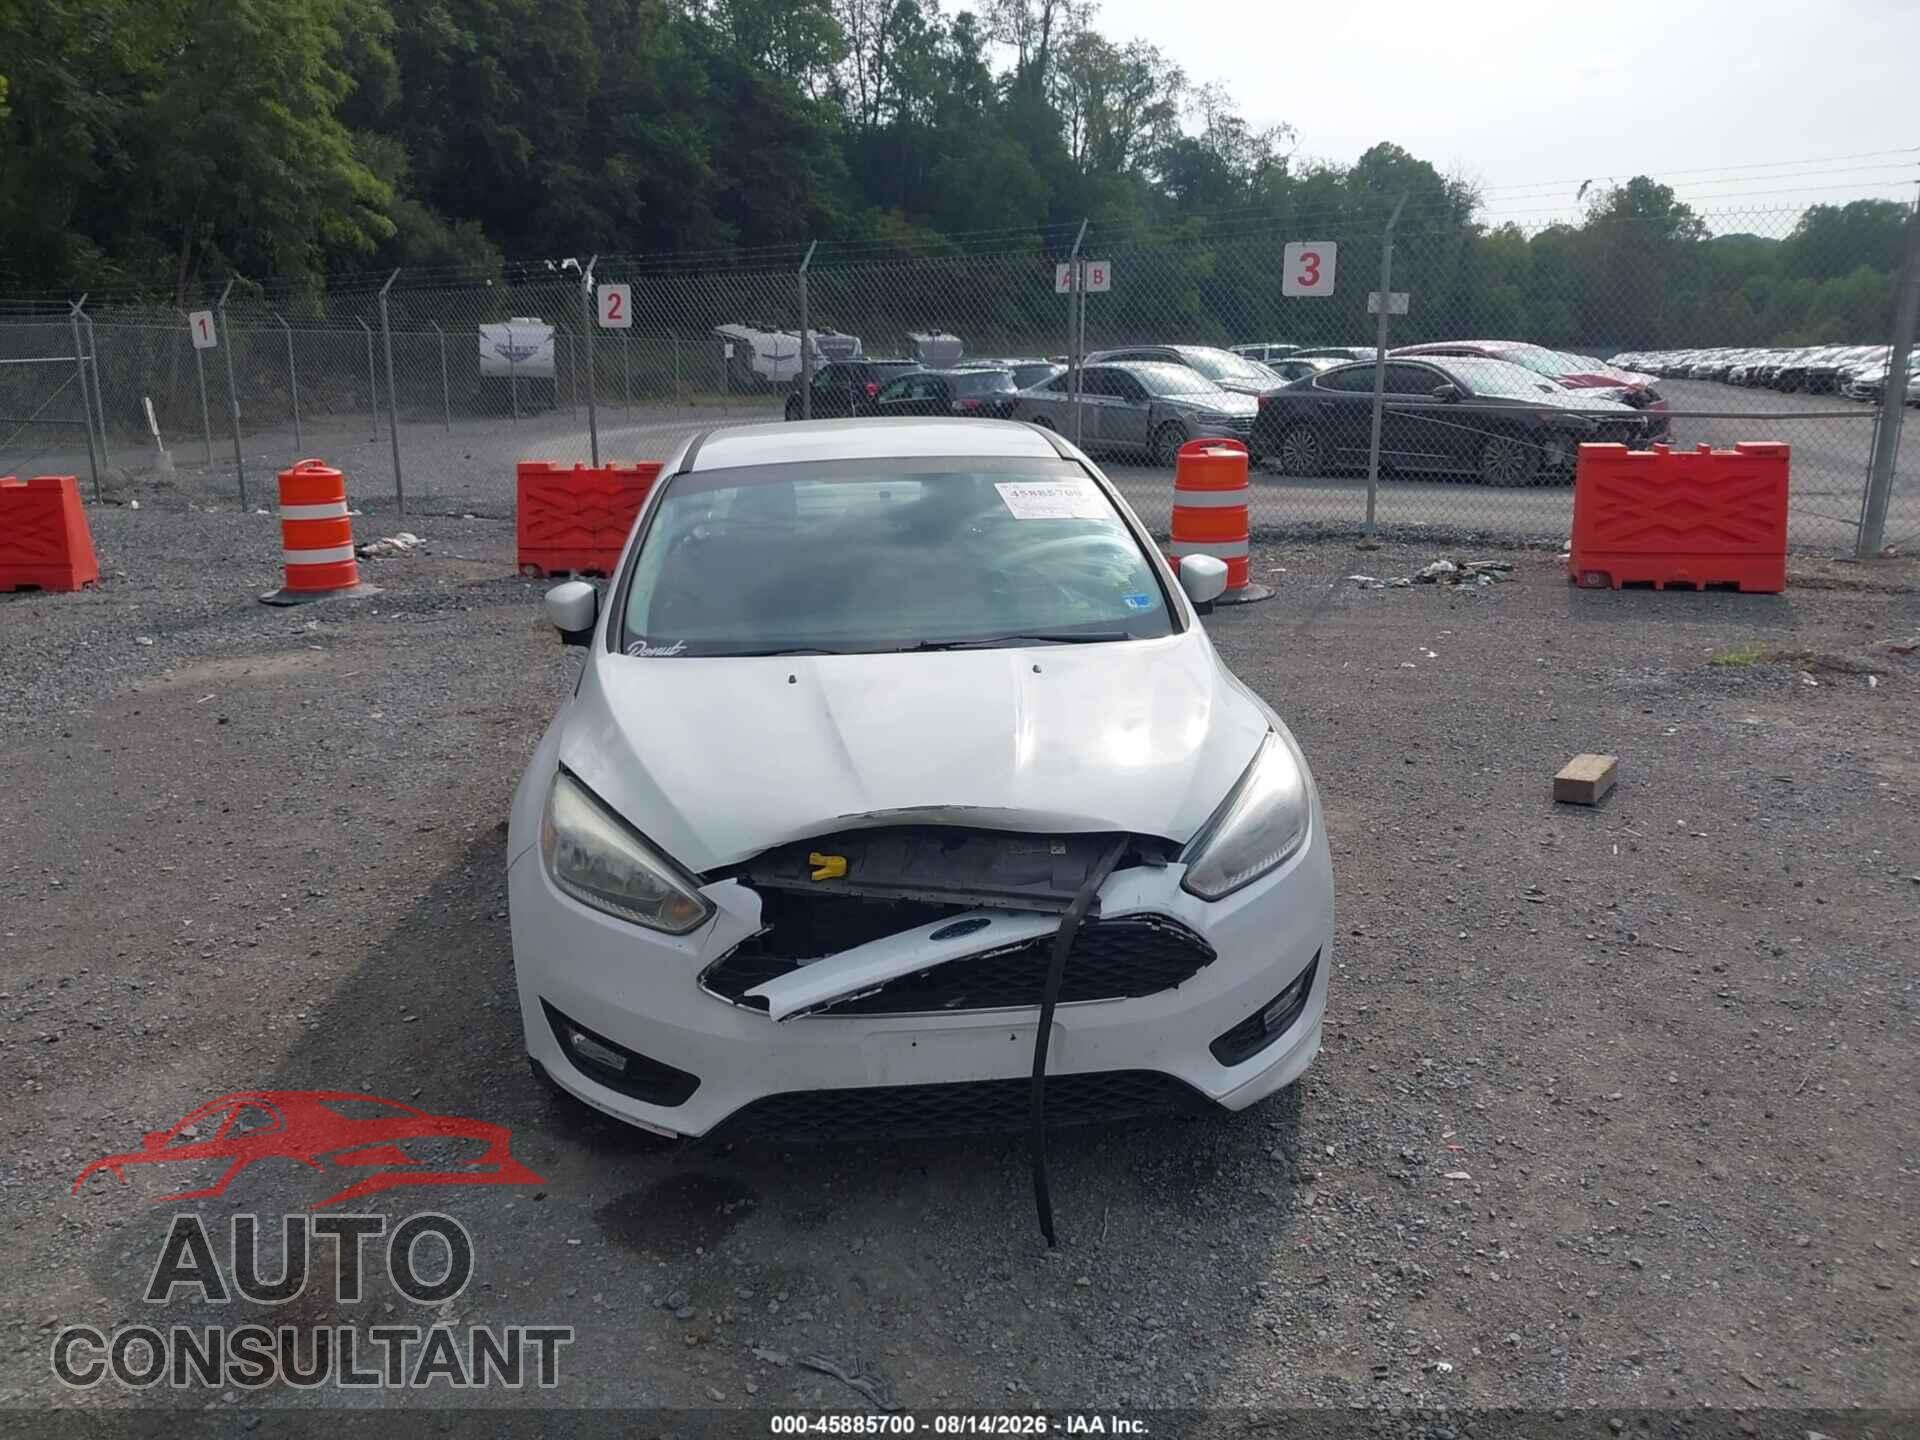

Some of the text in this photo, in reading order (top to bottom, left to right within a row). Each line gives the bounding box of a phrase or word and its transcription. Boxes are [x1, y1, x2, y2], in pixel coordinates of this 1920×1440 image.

[1094, 270, 1104, 284] B
[1297, 252, 1320, 286] 3
[608, 293, 622, 319] 2
[198, 319, 208, 340] 1
